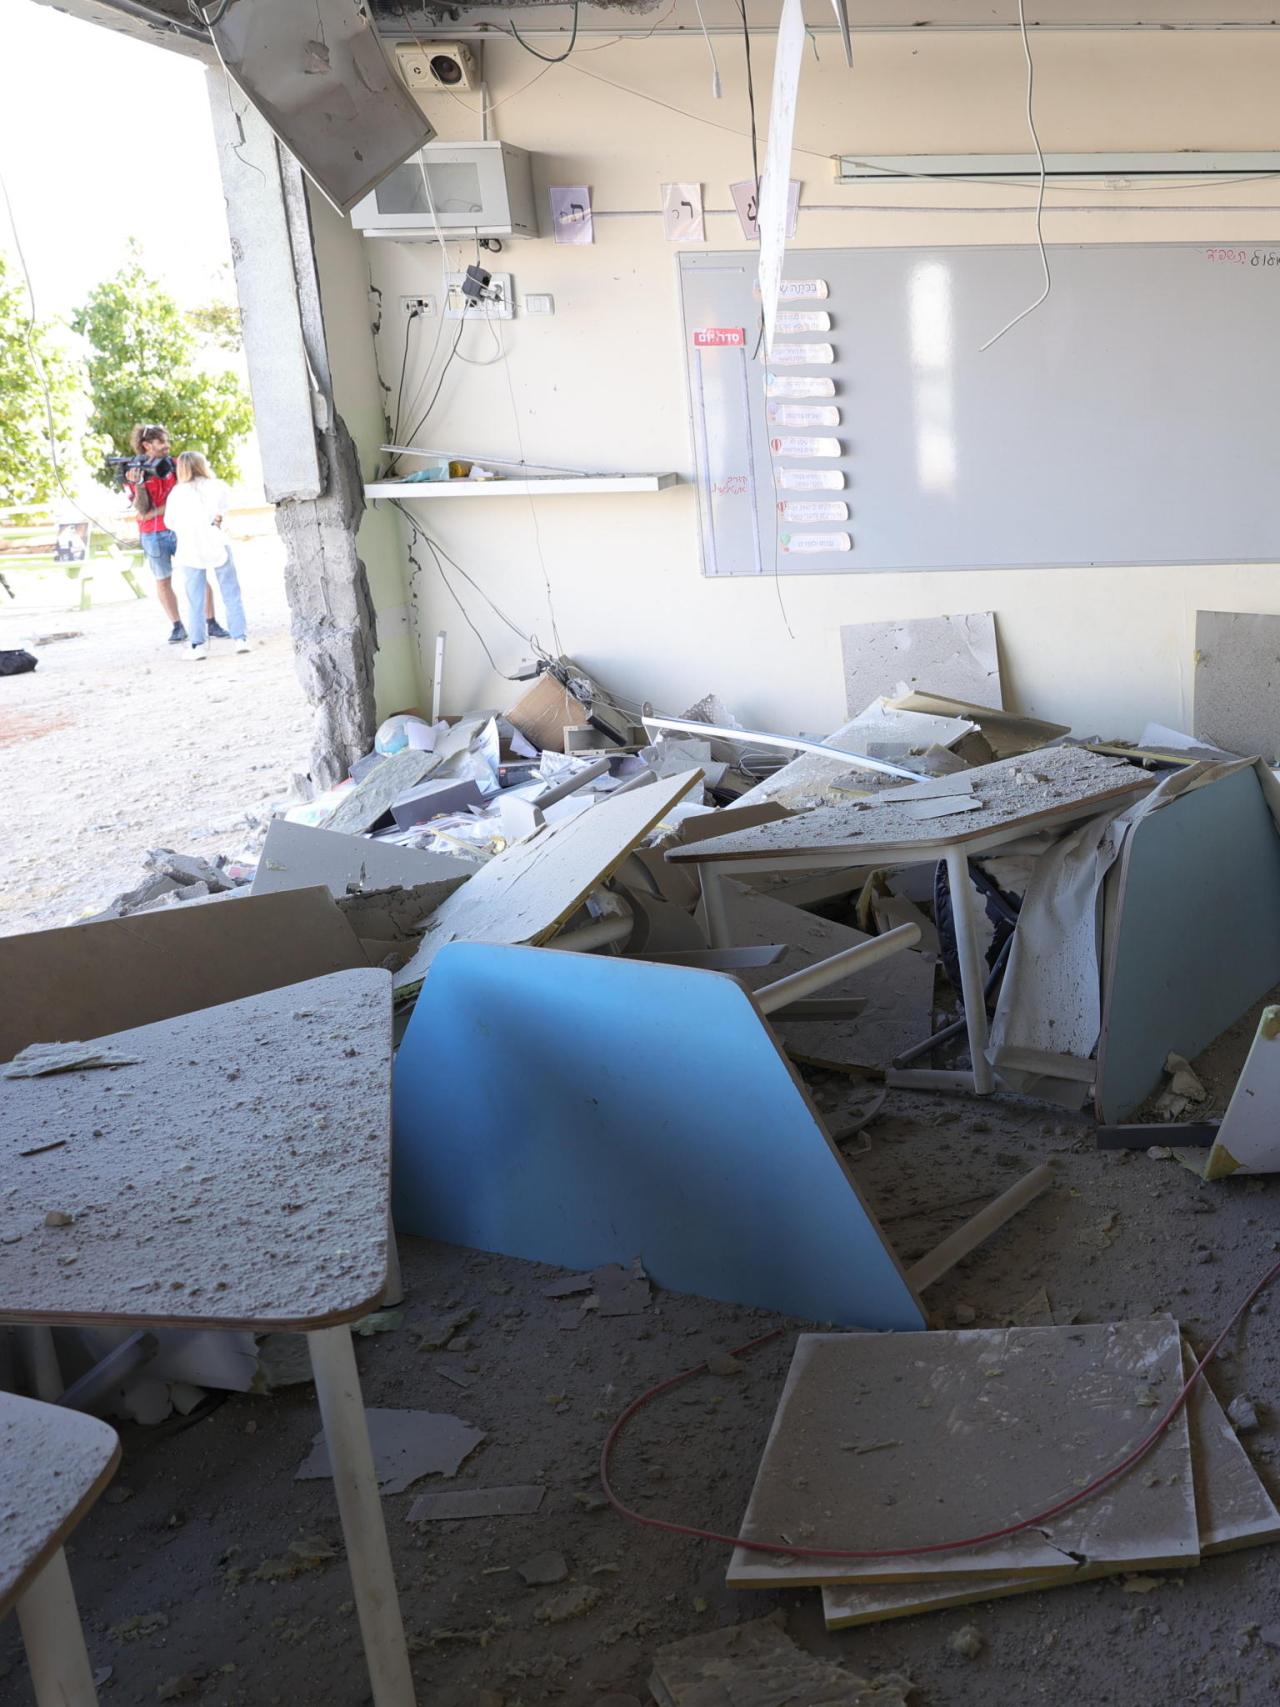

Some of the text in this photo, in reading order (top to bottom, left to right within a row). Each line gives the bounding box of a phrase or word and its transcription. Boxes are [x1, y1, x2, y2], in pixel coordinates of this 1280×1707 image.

[680, 200, 694, 219] ר
[698, 333, 740, 342] סדר יום
